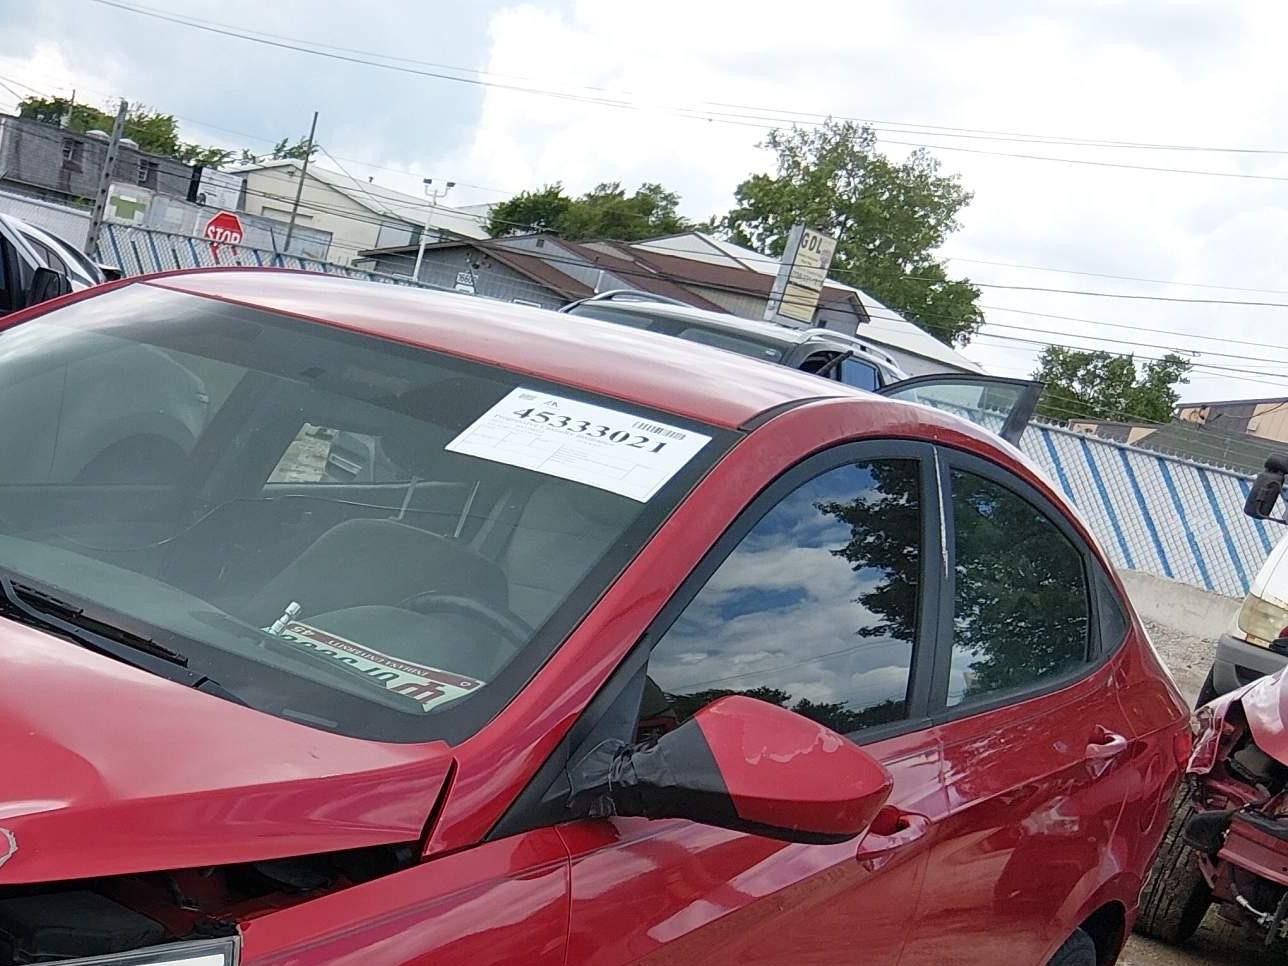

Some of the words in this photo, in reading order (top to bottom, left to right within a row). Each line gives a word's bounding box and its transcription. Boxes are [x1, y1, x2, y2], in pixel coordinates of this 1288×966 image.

[207, 225, 241, 244] STOP
[801, 232, 823, 254] GDL
[513, 407, 667, 454] 45333021
